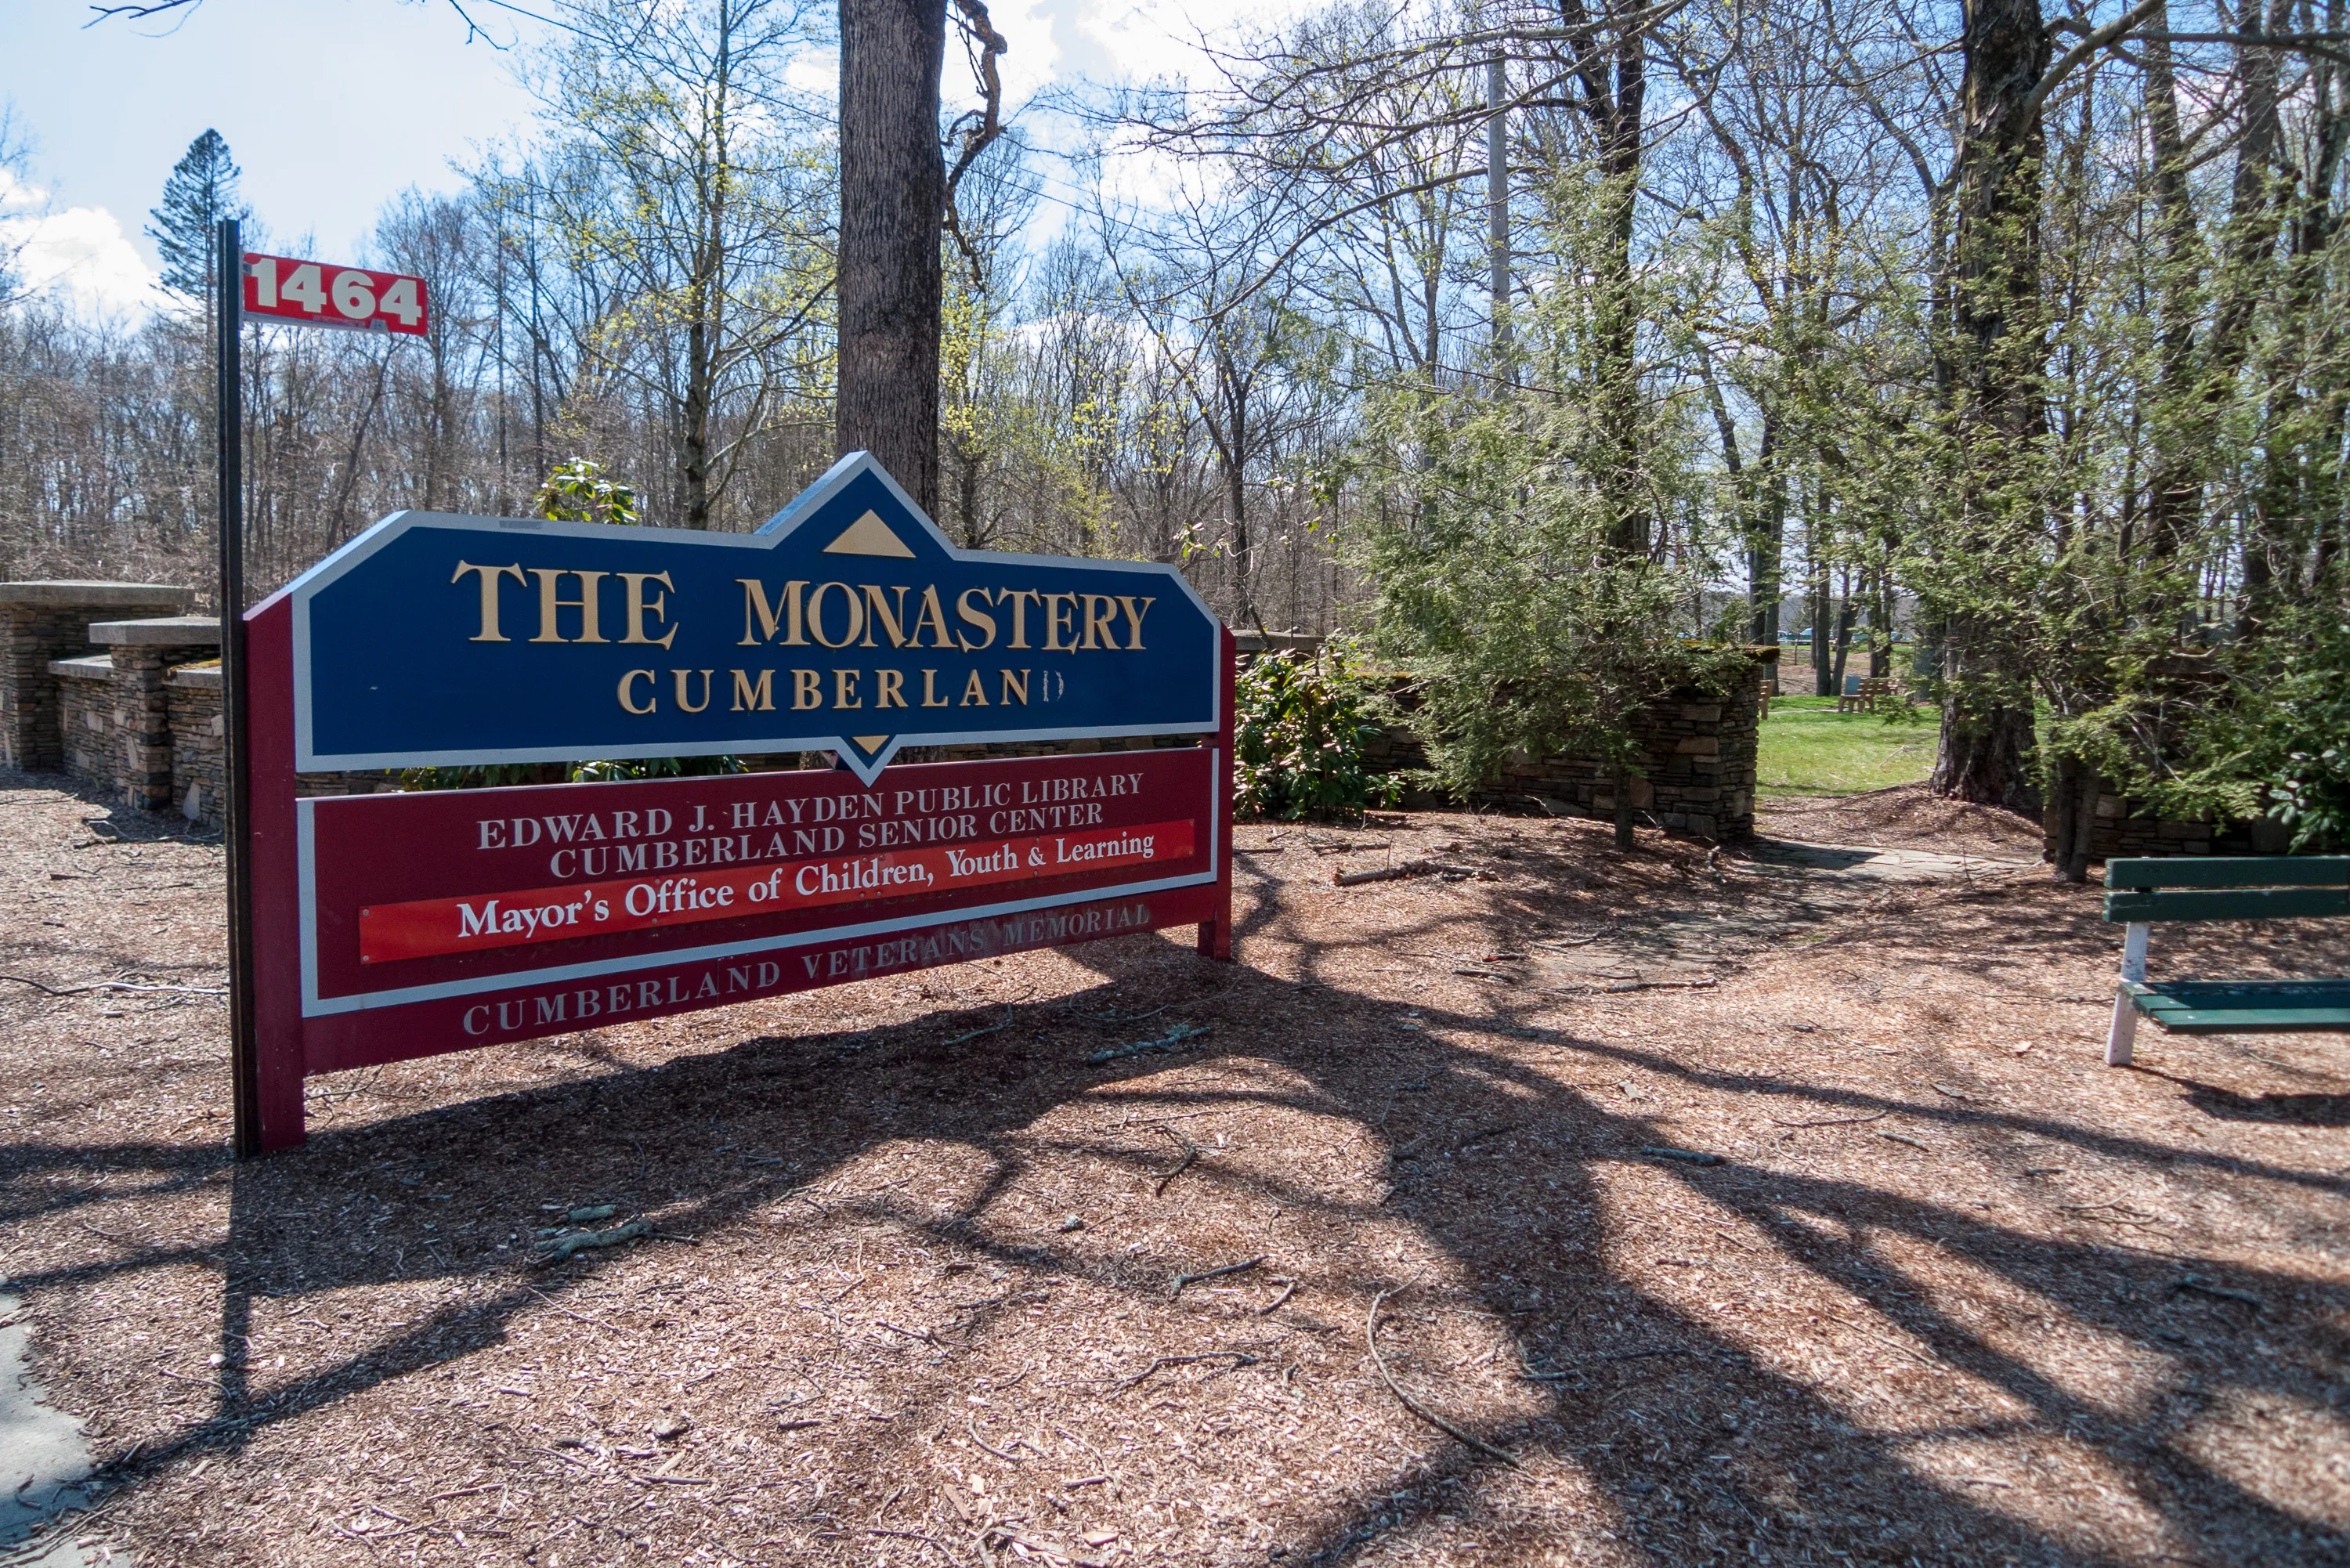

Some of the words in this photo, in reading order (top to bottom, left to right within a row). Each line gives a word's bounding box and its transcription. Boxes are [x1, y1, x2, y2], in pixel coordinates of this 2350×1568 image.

[251, 258, 422, 326] 1464
[450, 559, 679, 651] THE
[736, 578, 1157, 655] MONASTERY
[477, 808, 672, 850] EDWARD
[689, 804, 714, 832] J.
[731, 792, 884, 829] HAYDEN
[895, 782, 1010, 815] PUBLIC
[1021, 772, 1144, 804] LIBRARY
[550, 826, 844, 879] CUMBERLAND
[858, 814, 978, 848] SENIOR
[989, 803, 1104, 834] CENTER
[457, 890, 609, 938] Mayor's
[625, 877, 735, 917] Office
[748, 868, 782, 902] of
[795, 858, 935, 896] Children,
[945, 843, 1019, 878] Youth
[1027, 847, 1045, 867] &
[1055, 831, 1155, 864] Learning
[463, 960, 781, 1036] CUMBERLAND
[801, 928, 987, 981] VETERANS
[1003, 903, 1152, 948] MEMORIAL
